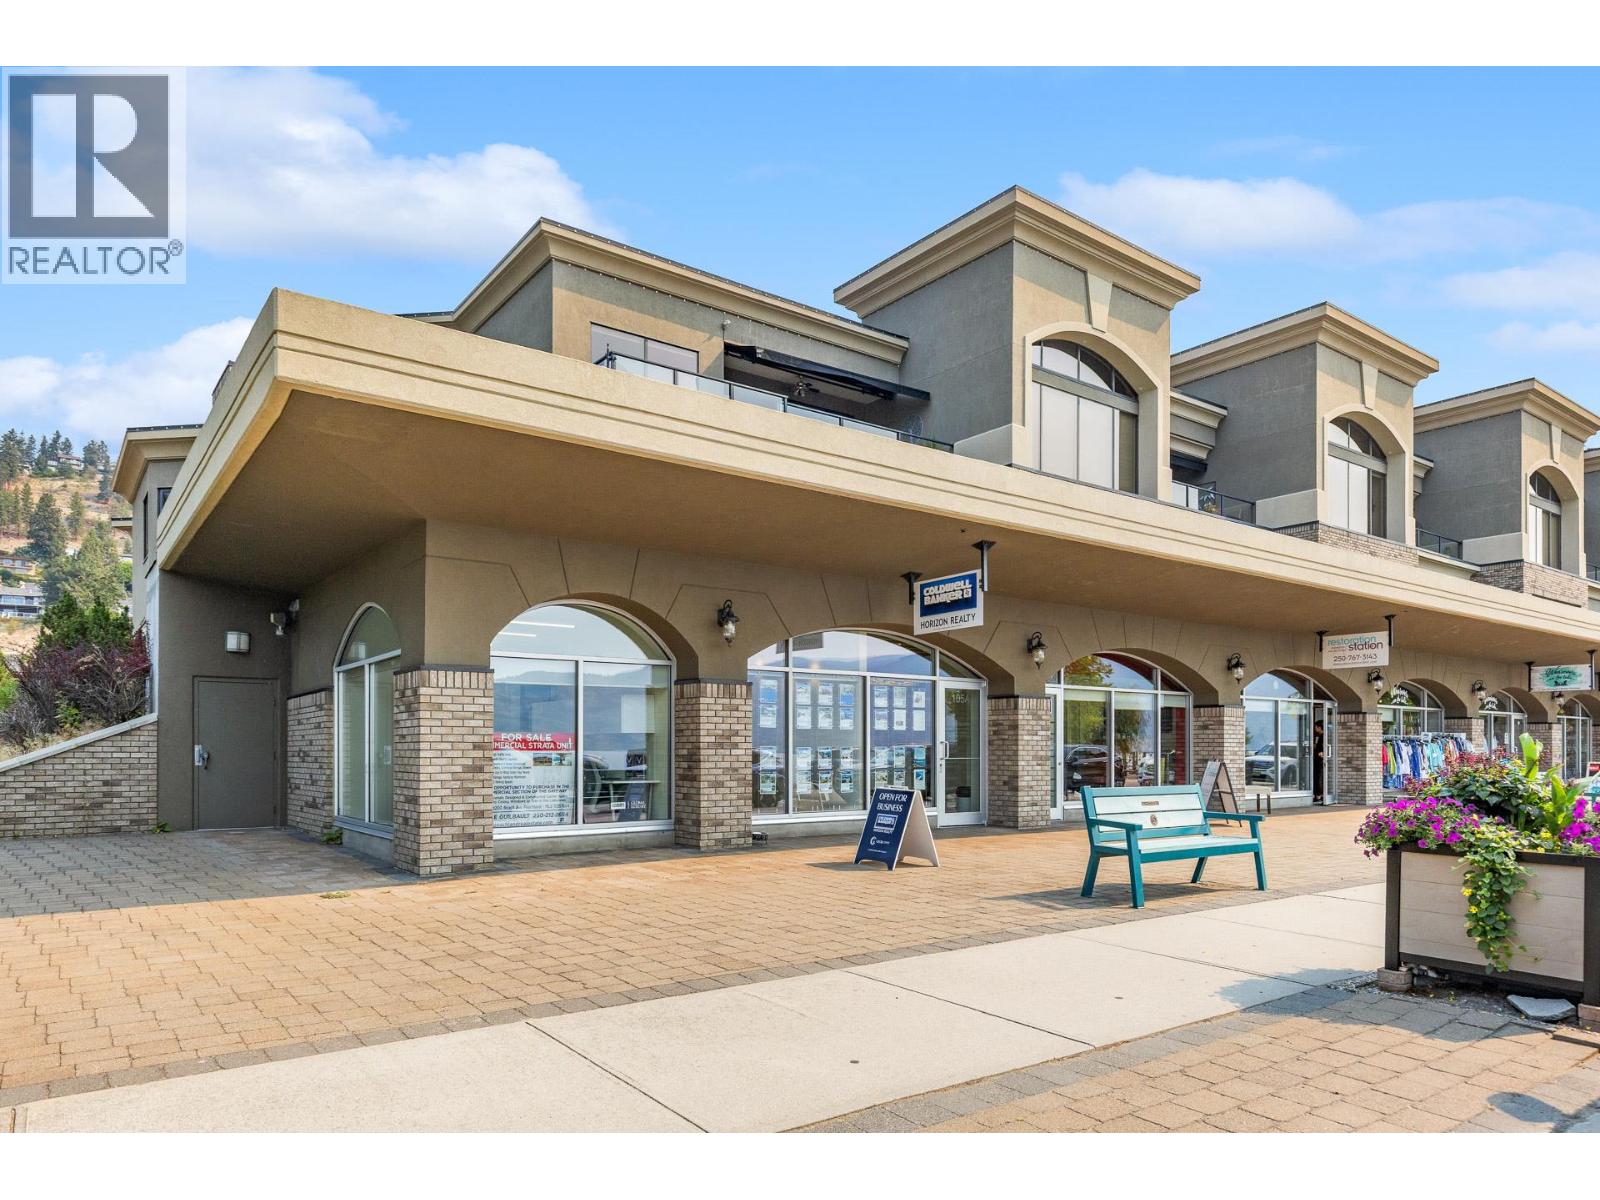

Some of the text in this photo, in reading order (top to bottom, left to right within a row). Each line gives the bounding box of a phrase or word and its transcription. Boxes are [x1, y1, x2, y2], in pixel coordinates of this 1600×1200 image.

[923, 579, 972, 596] COLDWELL
[923, 590, 963, 606] BANKER
[920, 613, 976, 629] HORIZON REALTY
[1328, 636, 1377, 646] restoration
[1348, 641, 1383, 651] station
[501, 733, 552, 741] FOR SALE
[493, 741, 526, 749] MERCIAL
[879, 792, 908, 802] OPEN FOR
[876, 802, 903, 812] BUSINESS
